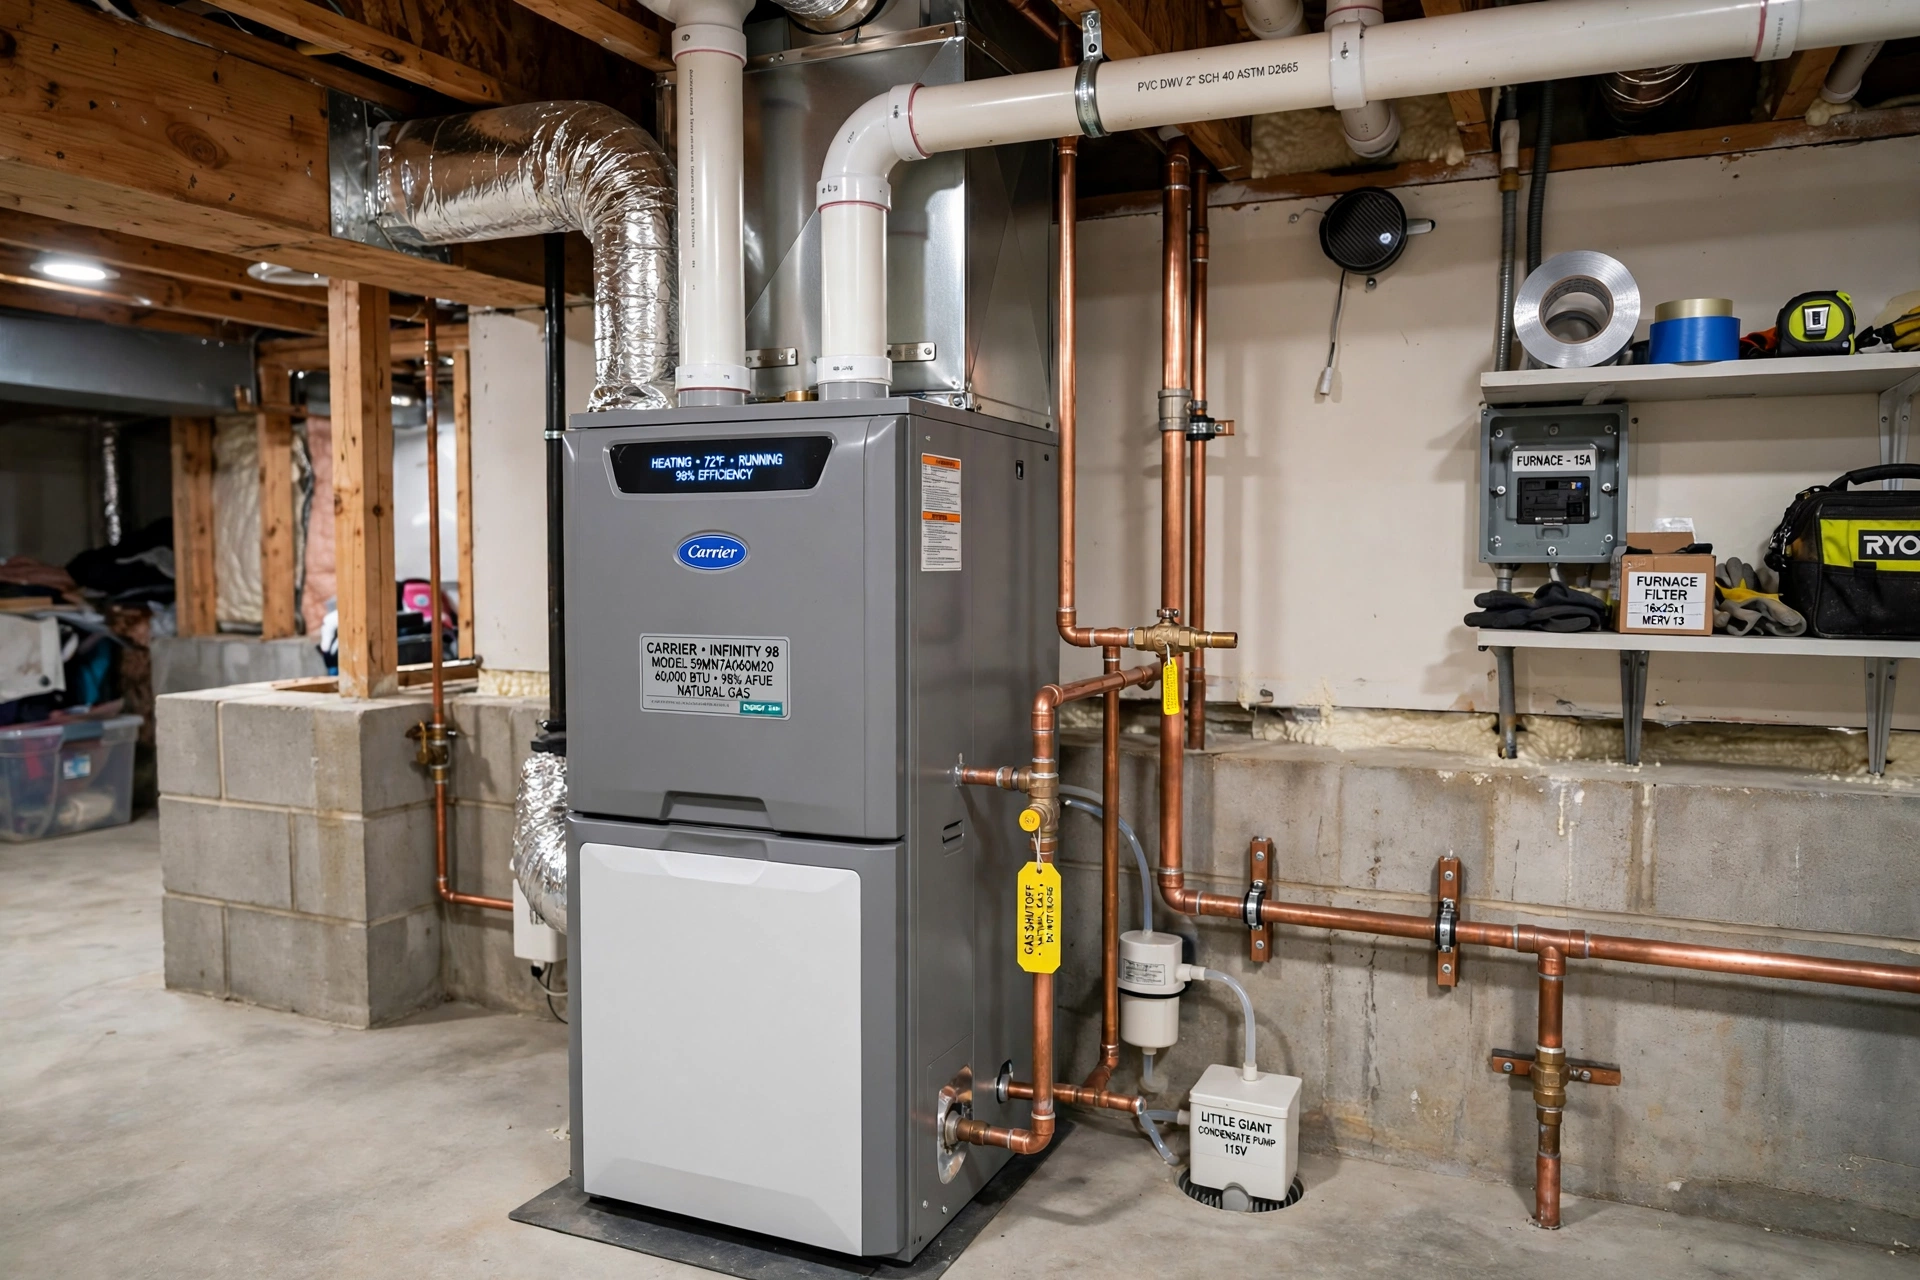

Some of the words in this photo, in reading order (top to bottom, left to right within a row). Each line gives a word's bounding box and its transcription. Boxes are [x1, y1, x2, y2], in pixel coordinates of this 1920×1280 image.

[1138, 80, 1158, 92] PVC
[1160, 77, 1184, 89] DWV
[1198, 72, 1220, 84] SCH
[1222, 71, 1234, 81] 40
[1237, 66, 1265, 80] ASTM
[1268, 62, 1299, 76] D2665
[651, 456, 692, 468] HEATING
[739, 453, 783, 466] RUNNING
[1517, 454, 1564, 466] FURNACE
[1574, 454, 1592, 466] 15A
[676, 470, 695, 481] 98%
[698, 468, 754, 480] EFFICIENCY
[688, 544, 738, 558] Carrier
[1636, 576, 1698, 587] FURNACE
[1645, 589, 1688, 600] FILTER
[1644, 603, 1684, 614] 16x25x1
[1642, 615, 1670, 626] MERV
[1673, 616, 1684, 626] 13
[646, 642, 698, 656] CARRIER
[710, 644, 761, 657] INFINITY
[765, 646, 780, 658] 98
[652, 656, 688, 668] MODEL
[655, 671, 686, 682] 60,000
[690, 672, 710, 684] BTU
[722, 674, 742, 685] 98%
[745, 675, 773, 686] AFUE
[677, 685, 725, 698] NATURAL
[728, 688, 750, 699] GAS
[1024, 884, 1034, 932] SHUTOFF
[1024, 934, 1034, 955] GAS
[1202, 1111, 1235, 1128] LITTLE
[1238, 1118, 1272, 1134] GIANT
[1198, 1126, 1250, 1144] CONDENSATE
[1252, 1136, 1276, 1148] PUMP
[1225, 1144, 1248, 1156] 115V
